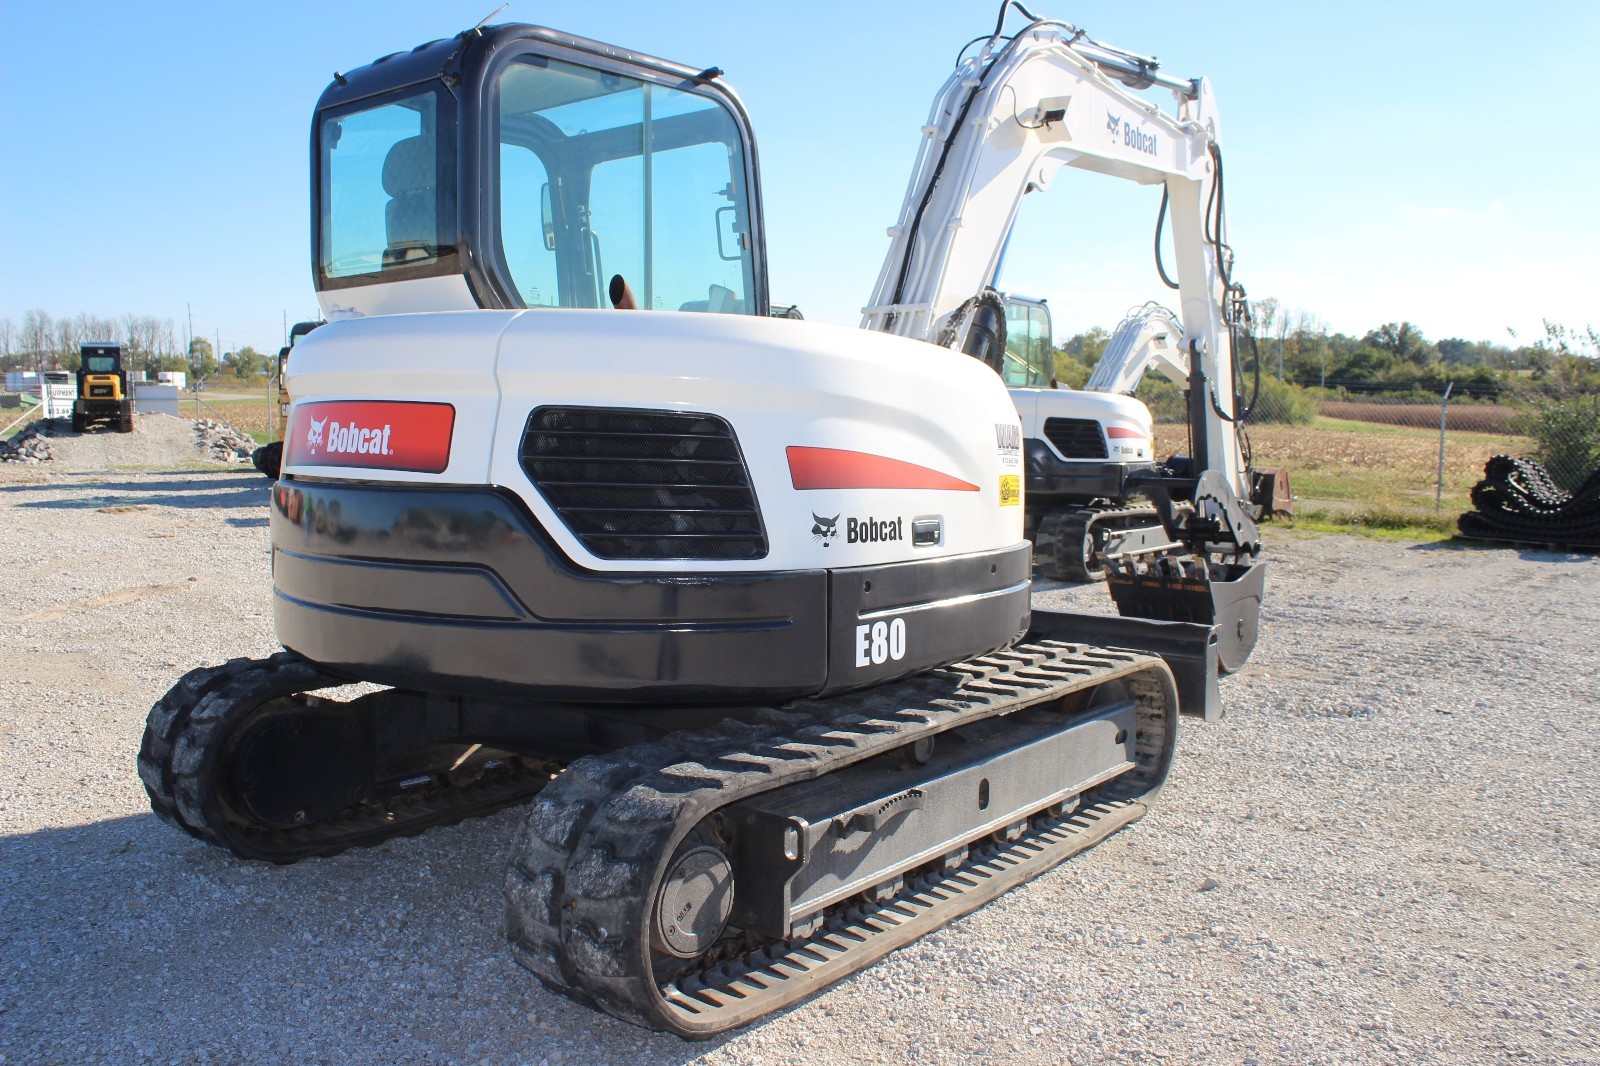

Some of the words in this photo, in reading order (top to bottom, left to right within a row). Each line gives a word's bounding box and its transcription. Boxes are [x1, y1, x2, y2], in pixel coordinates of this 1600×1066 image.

[1124, 121, 1157, 157] Bobcat
[327, 421, 391, 455] Bobcat
[846, 516, 903, 544] Bobcat
[855, 617, 906, 668] E80
